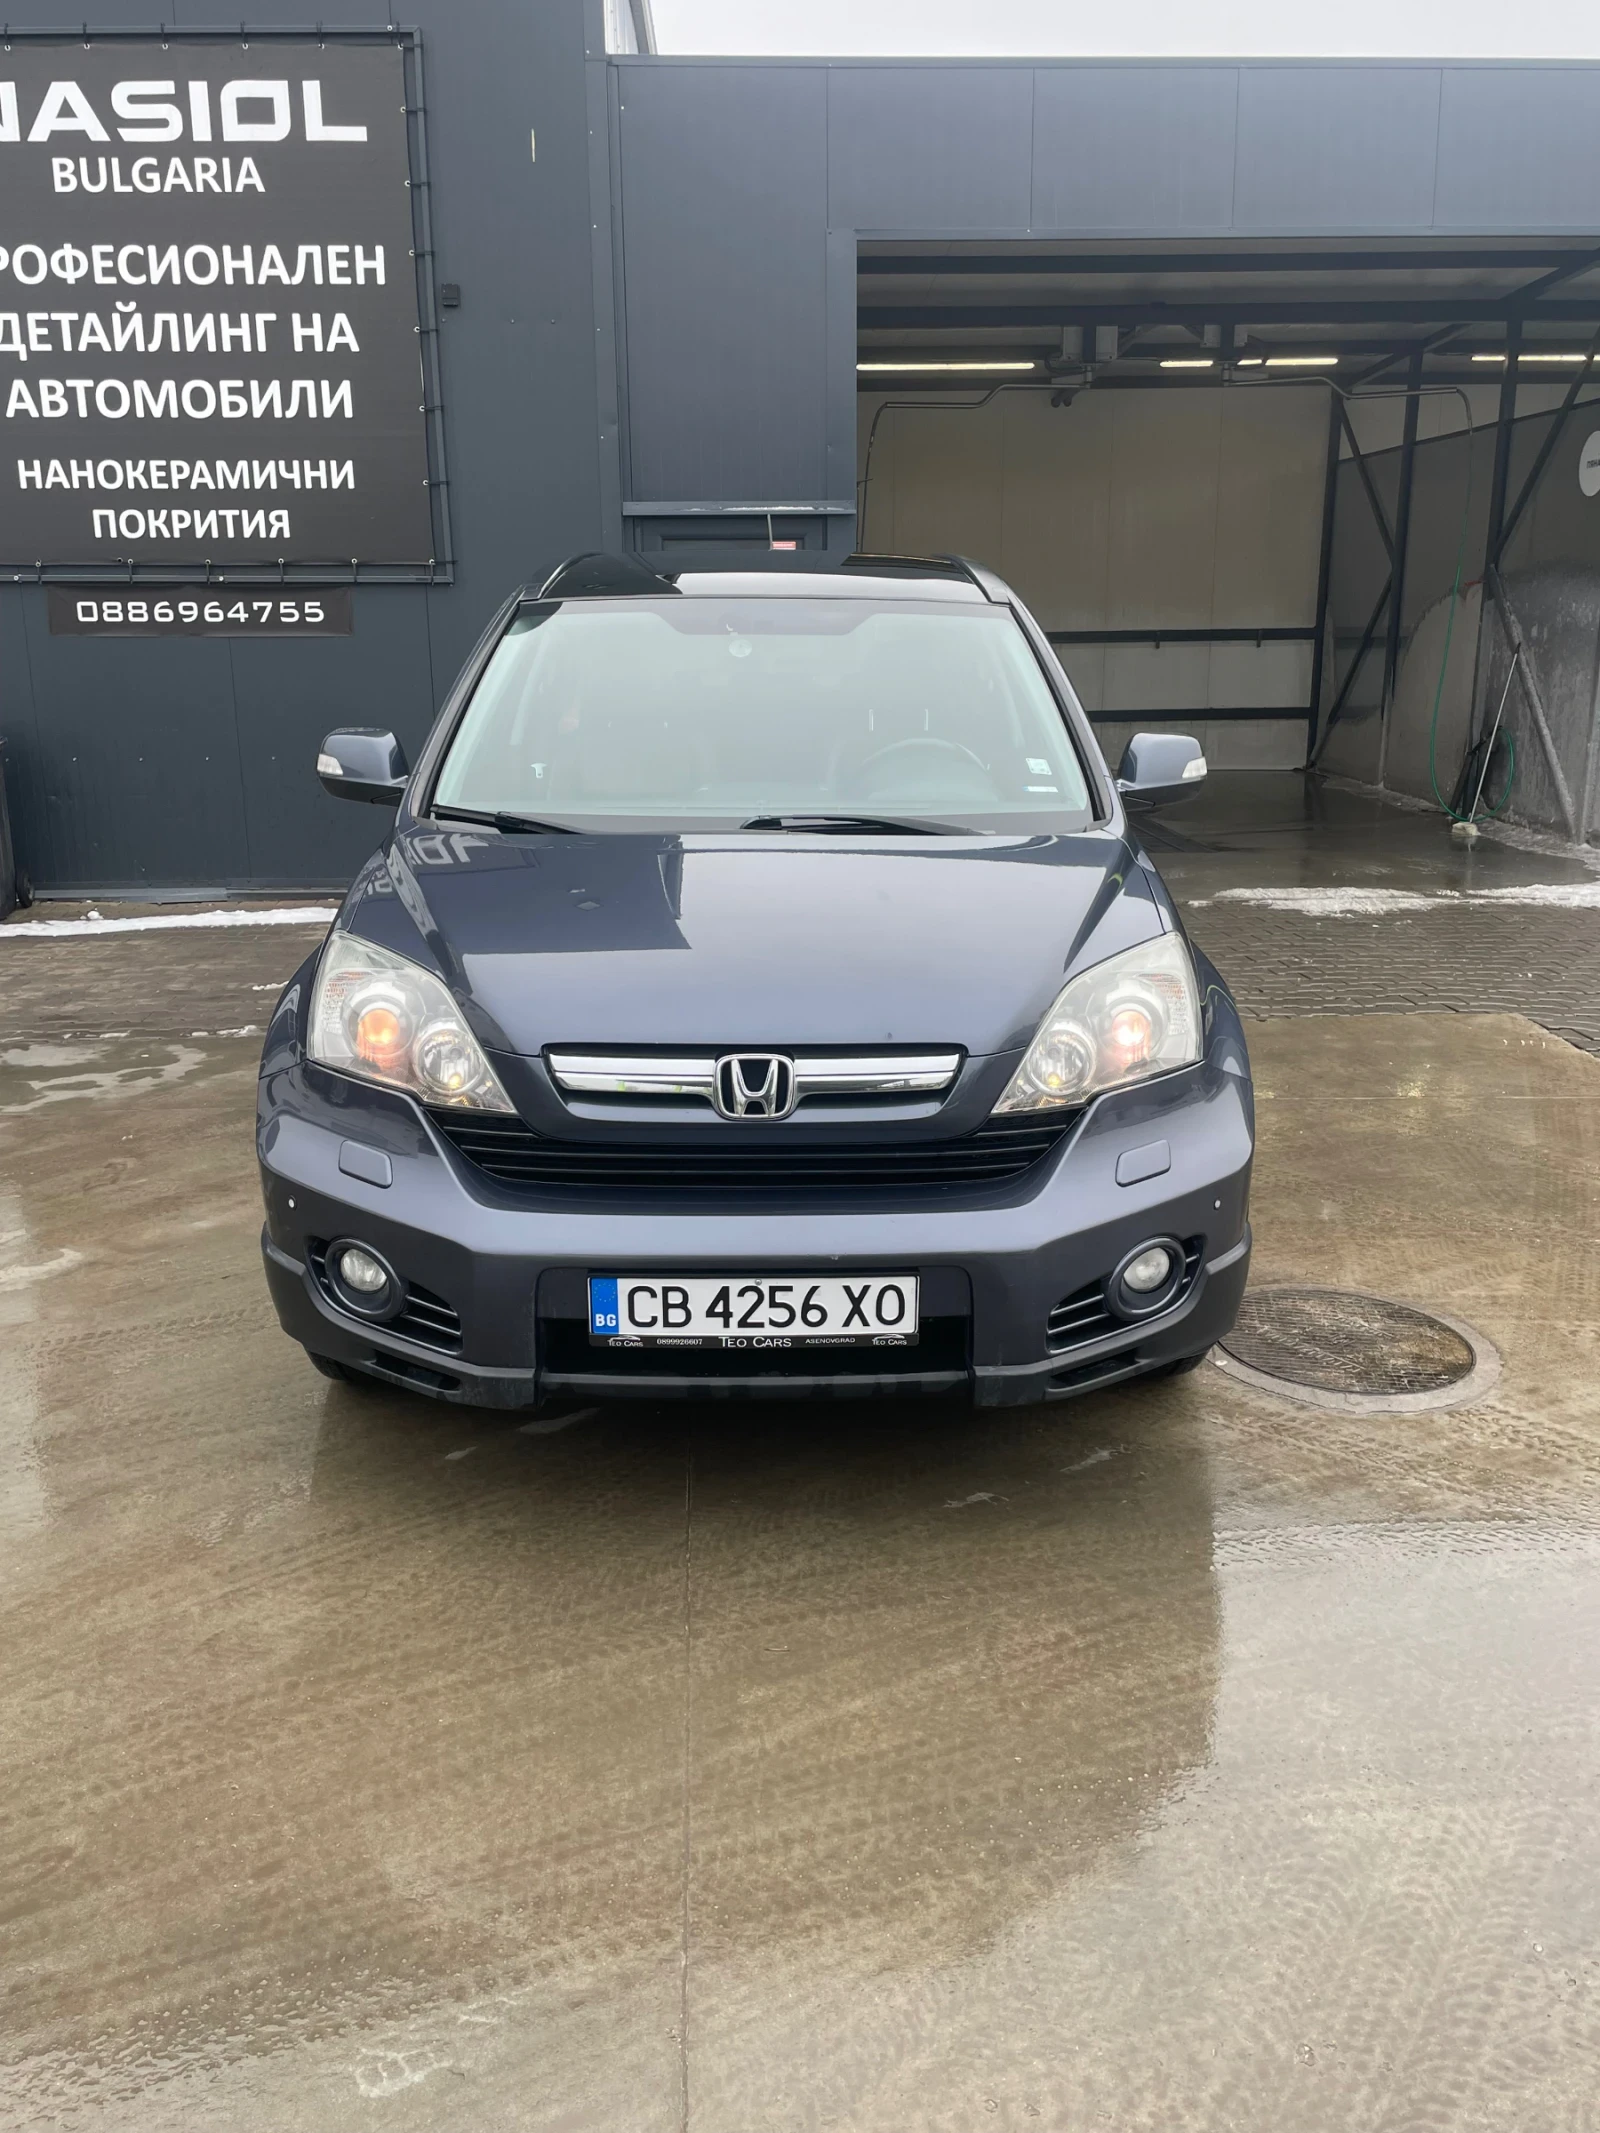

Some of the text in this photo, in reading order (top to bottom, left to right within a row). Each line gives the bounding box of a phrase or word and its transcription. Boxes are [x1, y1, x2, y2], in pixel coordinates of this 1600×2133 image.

[52, 157, 266, 193] BULGARIA
[0, 301, 360, 362] ДЕТАЙЛИНГ НА
[6, 379, 354, 418] АВТОМОБИЛИ
[18, 460, 355, 489] НАНОКЕРАМИЧНИ
[92, 509, 291, 538] ПОКРИТИЯ
[76, 601, 325, 623] 0886964755
[595, 1313, 617, 1327] BG
[627, 1284, 906, 1328] CB 4256 XO
[607, 1339, 644, 1347] TEO CARS
[718, 1336, 792, 1348] TEO CARS
[872, 1338, 908, 1346] TEO CARS
